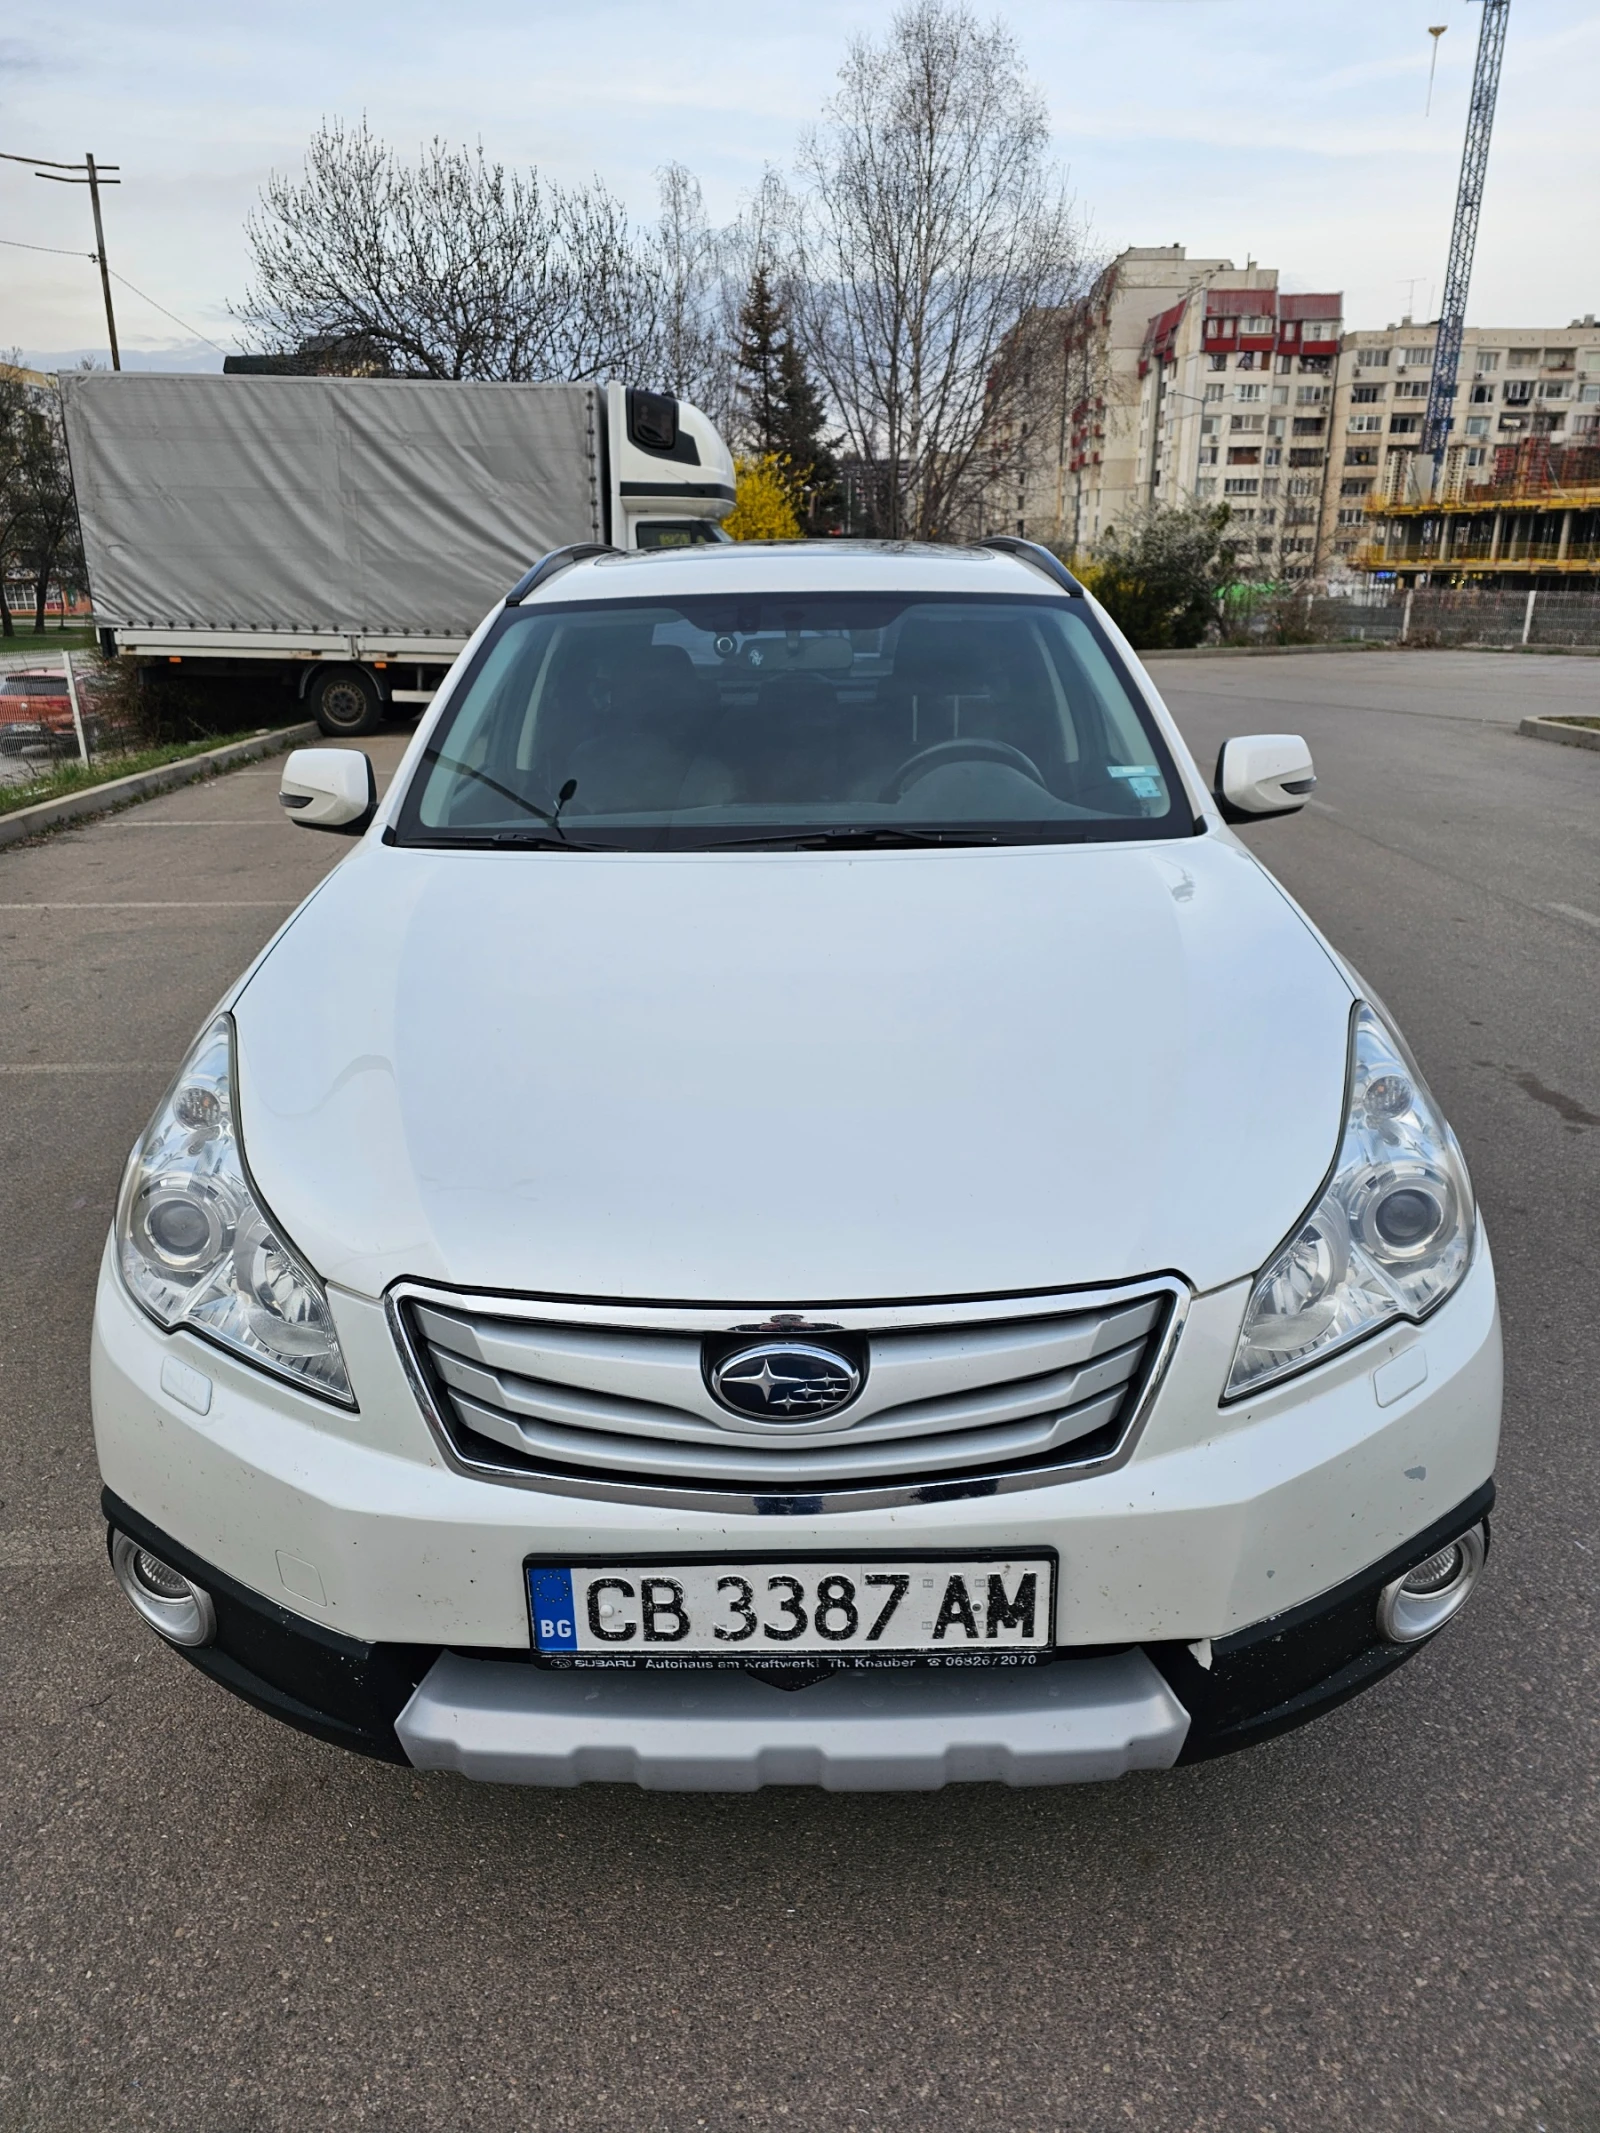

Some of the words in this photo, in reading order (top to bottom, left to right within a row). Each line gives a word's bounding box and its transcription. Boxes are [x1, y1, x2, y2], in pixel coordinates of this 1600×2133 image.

[586, 1575, 691, 1642] CB
[713, 1573, 911, 1642] 3387
[932, 1572, 1038, 1640] AM
[540, 1619, 572, 1638] BG
[574, 1659, 637, 1668] SUBARU
[645, 1658, 714, 1669] Autohaus
[827, 1658, 850, 1669] Th.
[854, 1657, 917, 1669] Knauber
